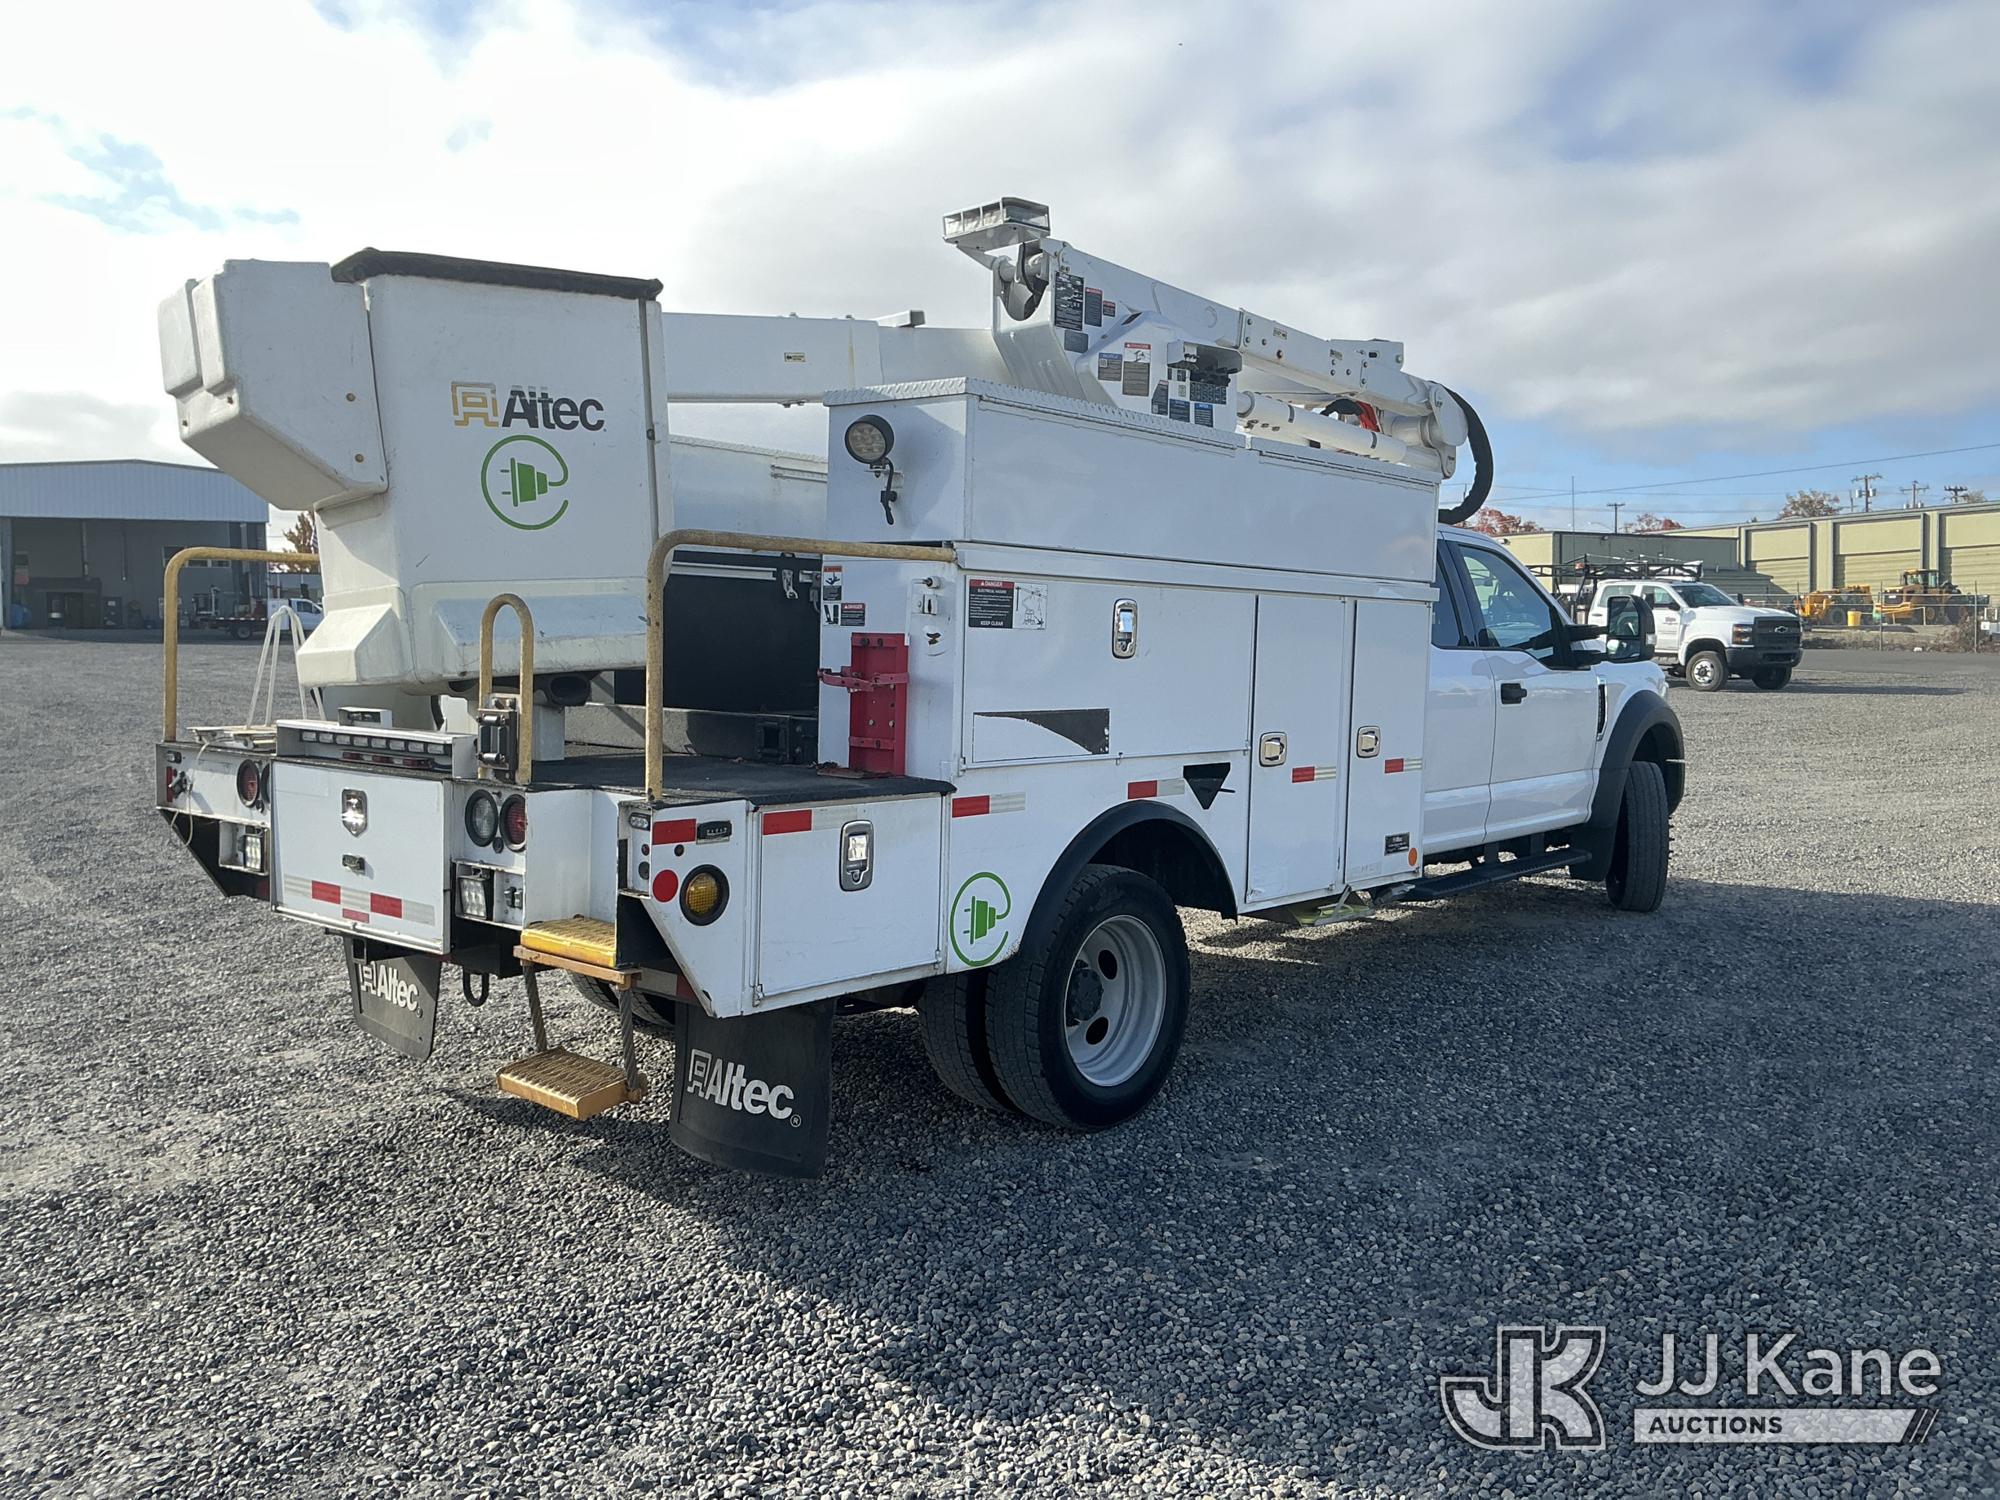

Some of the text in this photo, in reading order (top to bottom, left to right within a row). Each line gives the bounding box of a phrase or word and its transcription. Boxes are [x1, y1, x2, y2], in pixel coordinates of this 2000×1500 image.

[502, 386, 605, 431] Altec
[377, 964, 418, 1011] Altec
[704, 1058, 795, 1119] Altec
